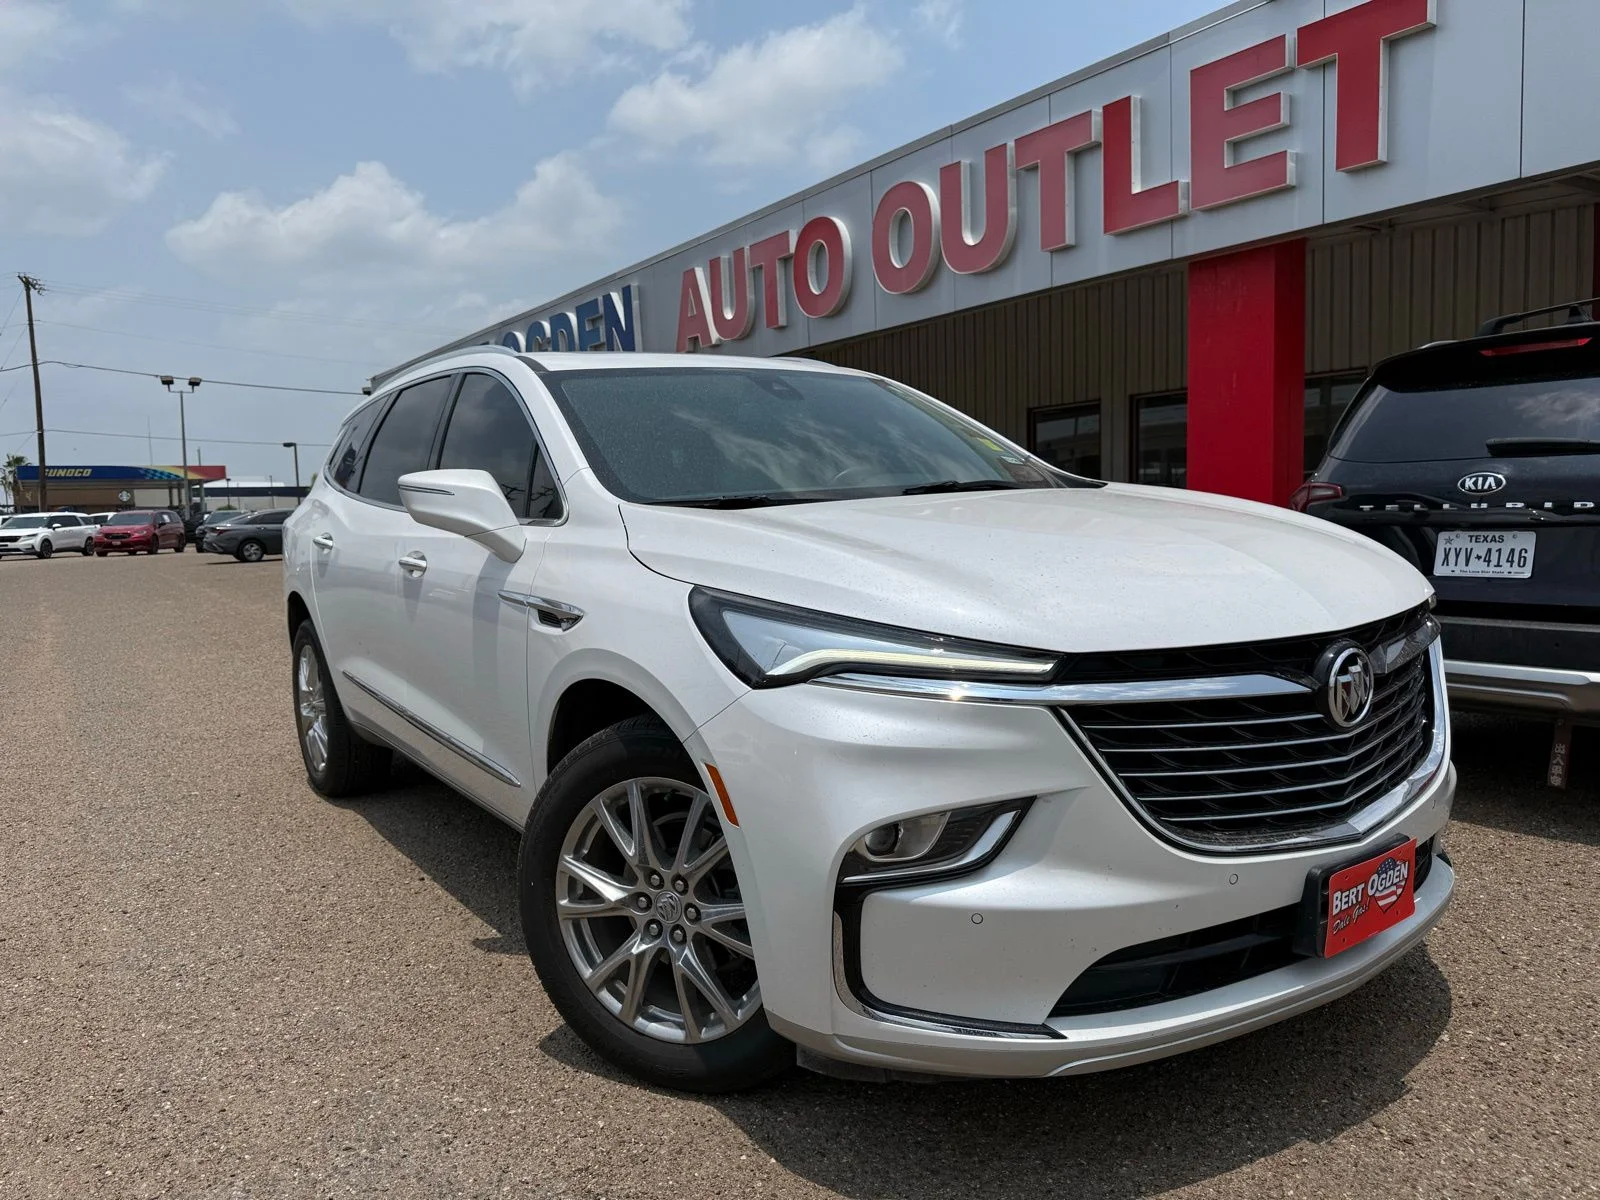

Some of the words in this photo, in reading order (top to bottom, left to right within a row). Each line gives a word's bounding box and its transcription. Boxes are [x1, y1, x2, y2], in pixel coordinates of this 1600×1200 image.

[675, 216, 853, 353] AUTO
[871, 0, 1437, 296] OUTLET
[1464, 476, 1497, 490] KIA
[1468, 534, 1505, 544] TEXAS
[1332, 883, 1365, 915] BERT
[1368, 861, 1408, 896] OGDEN
